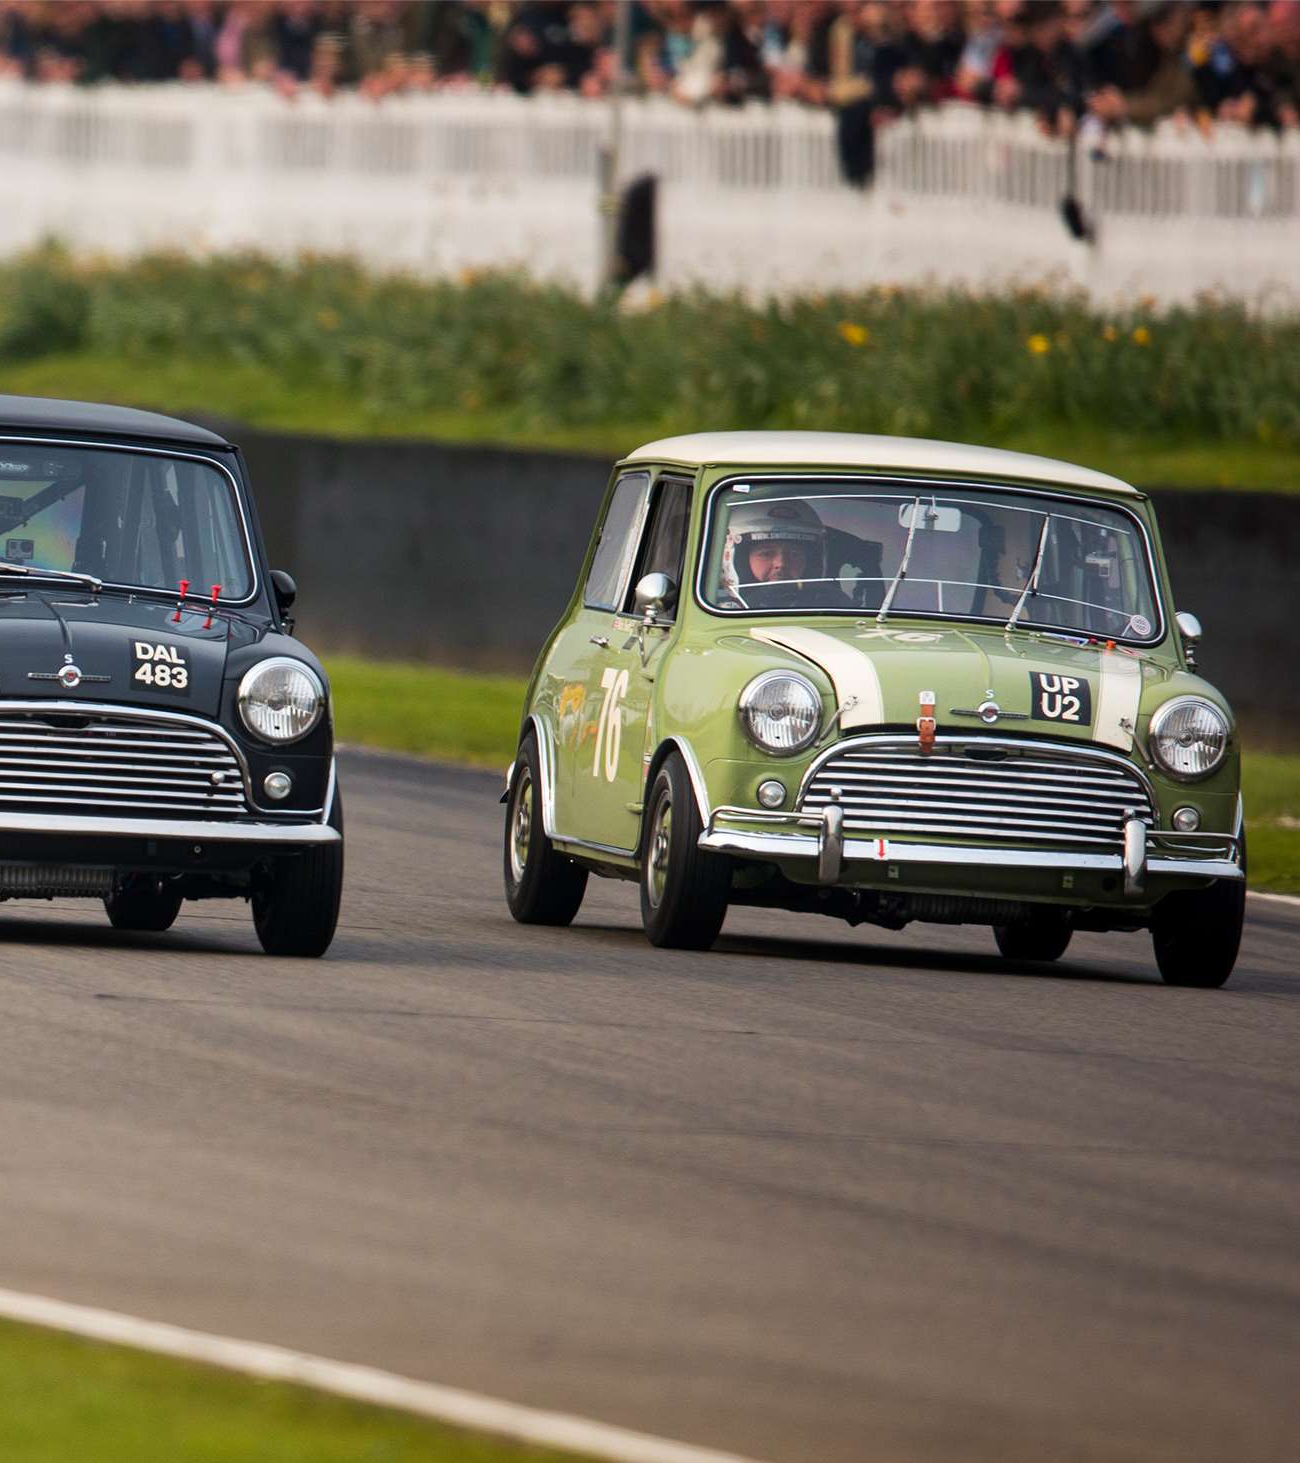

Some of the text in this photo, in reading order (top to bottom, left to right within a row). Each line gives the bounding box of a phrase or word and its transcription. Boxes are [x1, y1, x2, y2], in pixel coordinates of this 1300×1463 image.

[64, 653, 74, 664] S
[134, 641, 186, 665] DAL
[134, 662, 189, 689] 483
[1039, 673, 1080, 695] UP
[985, 689, 995, 699] S
[1041, 692, 1081, 721] U2
[593, 667, 629, 783] 76
